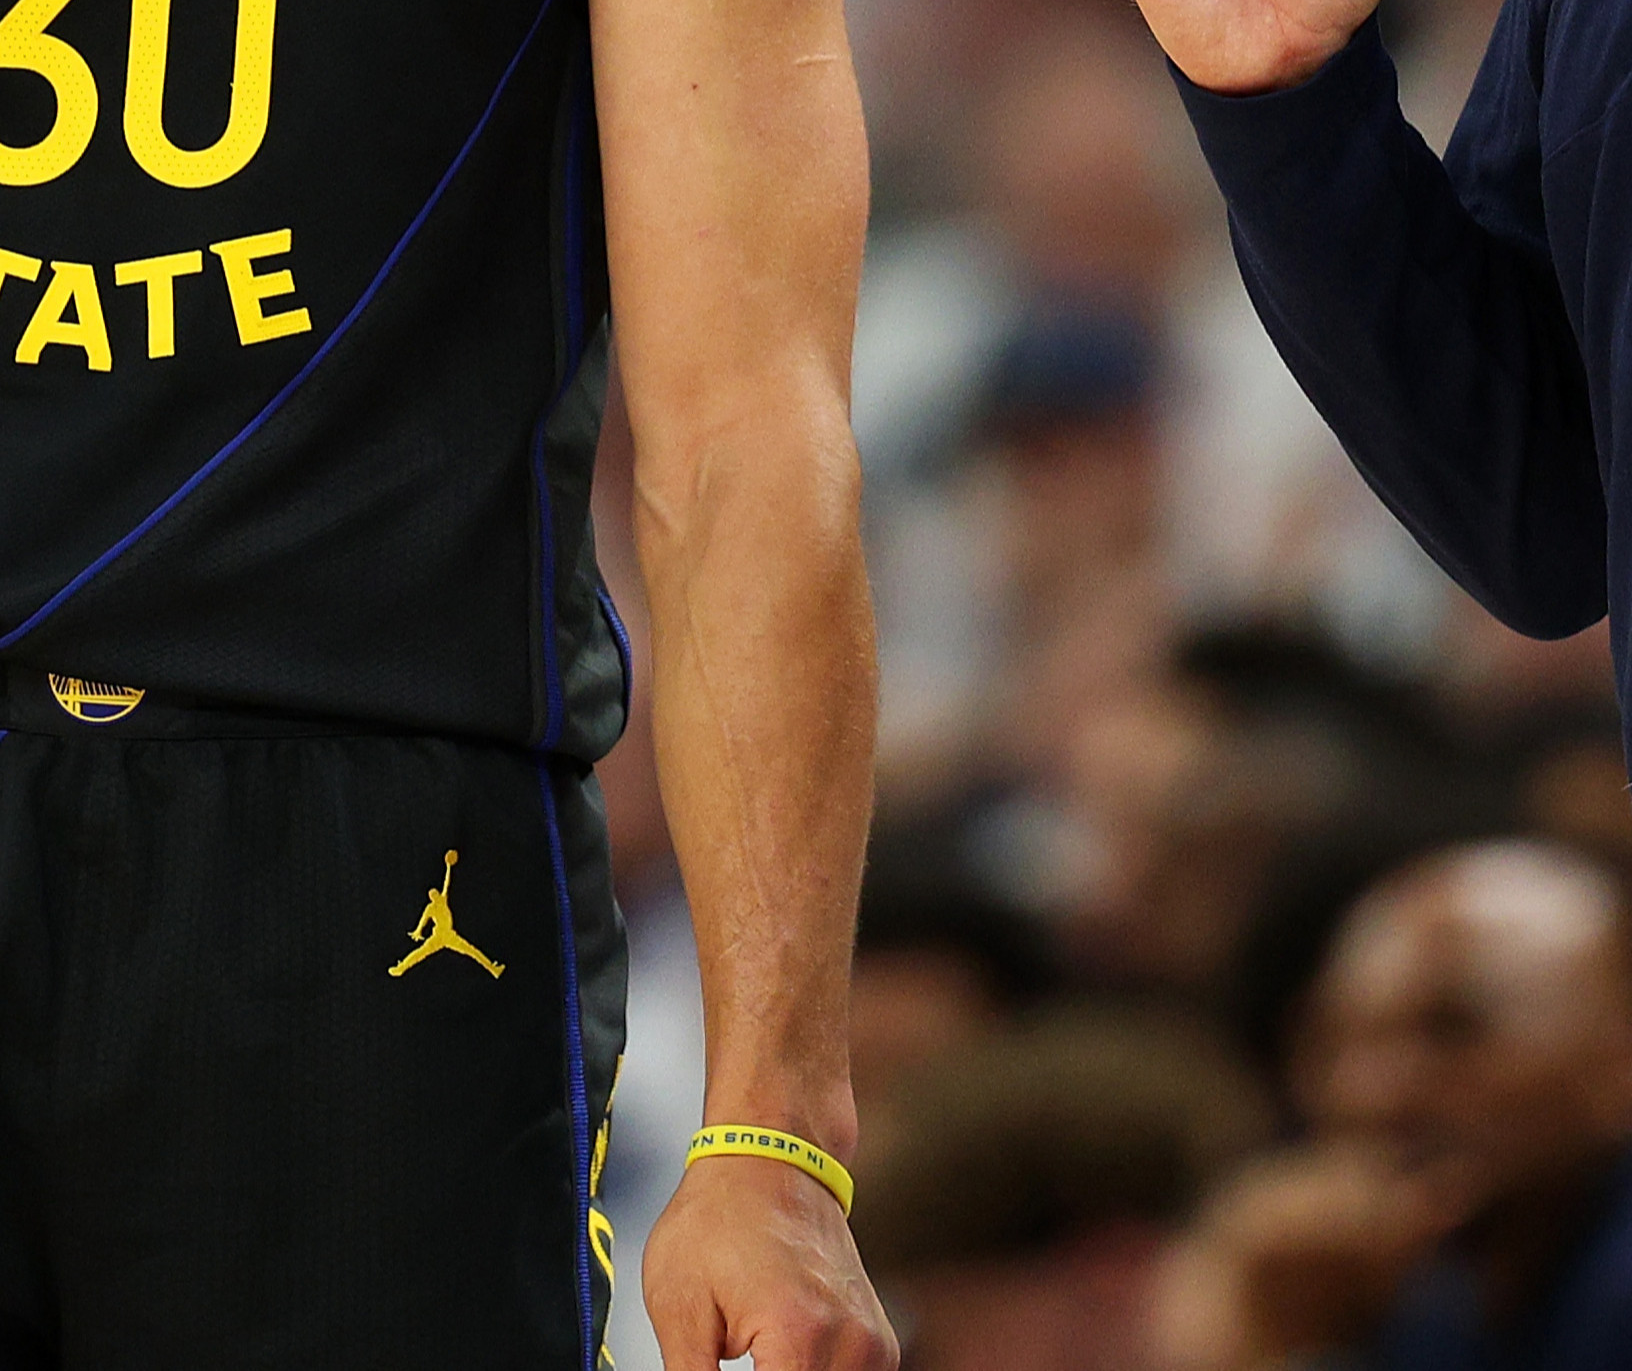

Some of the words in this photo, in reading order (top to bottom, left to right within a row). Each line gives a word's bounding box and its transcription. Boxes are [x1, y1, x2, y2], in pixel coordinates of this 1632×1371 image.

[688, 1134, 714, 1152] NA
[724, 1132, 799, 1154] JESUS
[806, 1151, 823, 1170] IN
